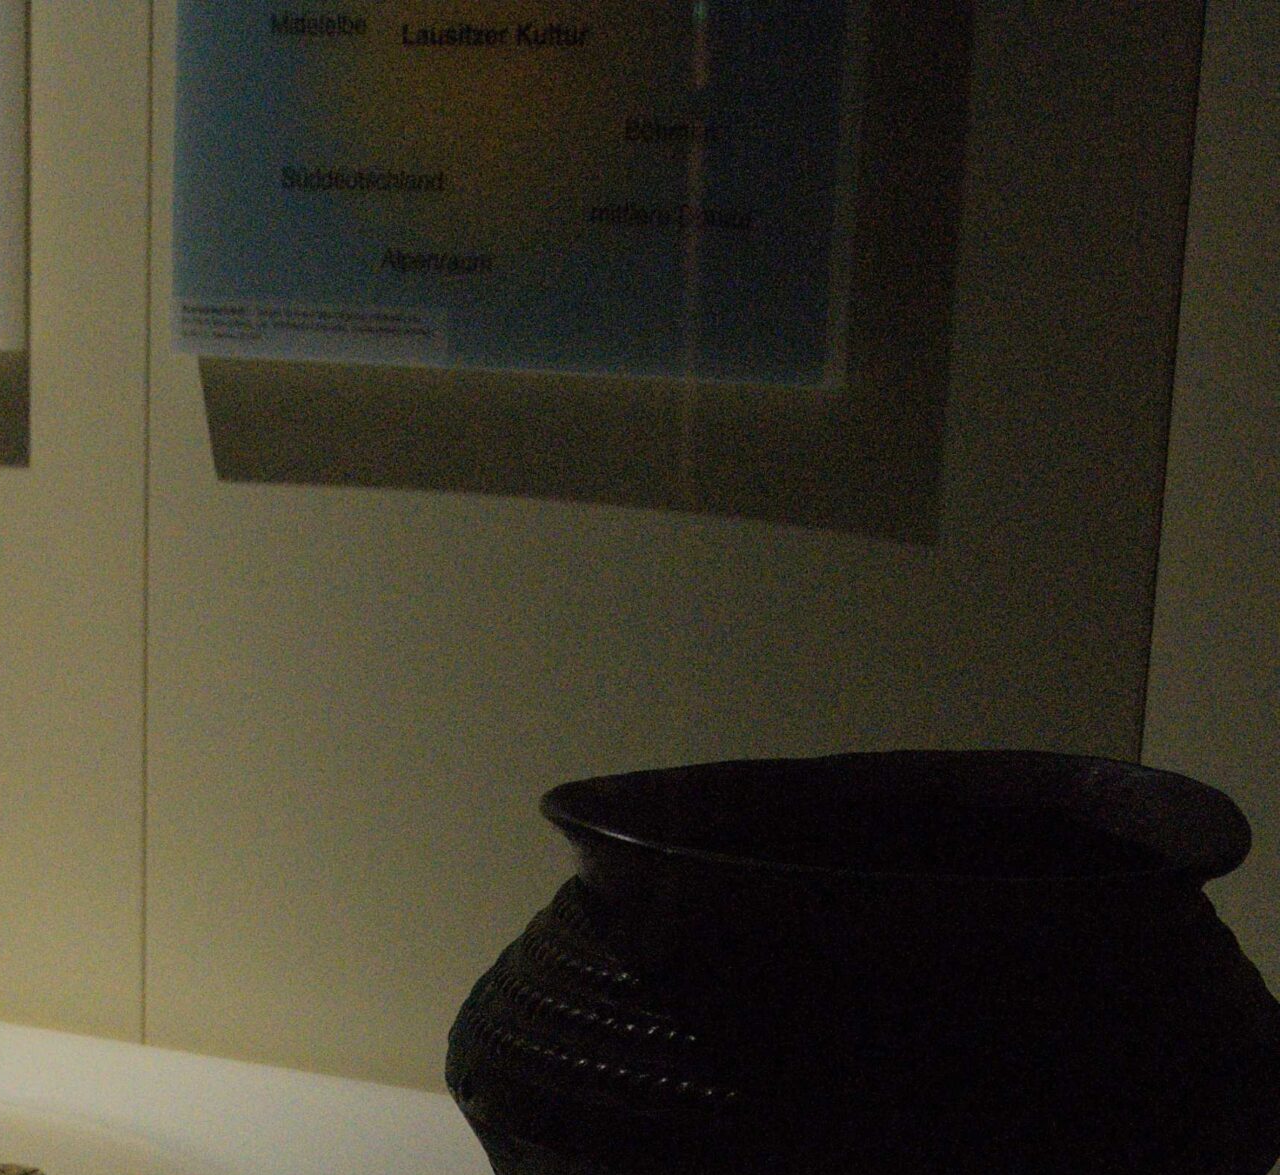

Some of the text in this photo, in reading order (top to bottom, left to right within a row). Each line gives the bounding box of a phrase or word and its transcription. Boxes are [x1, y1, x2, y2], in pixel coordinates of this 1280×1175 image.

[402, 22, 590, 47] Lausitzer Kultur
[280, 165, 445, 192] Süddeutschland
